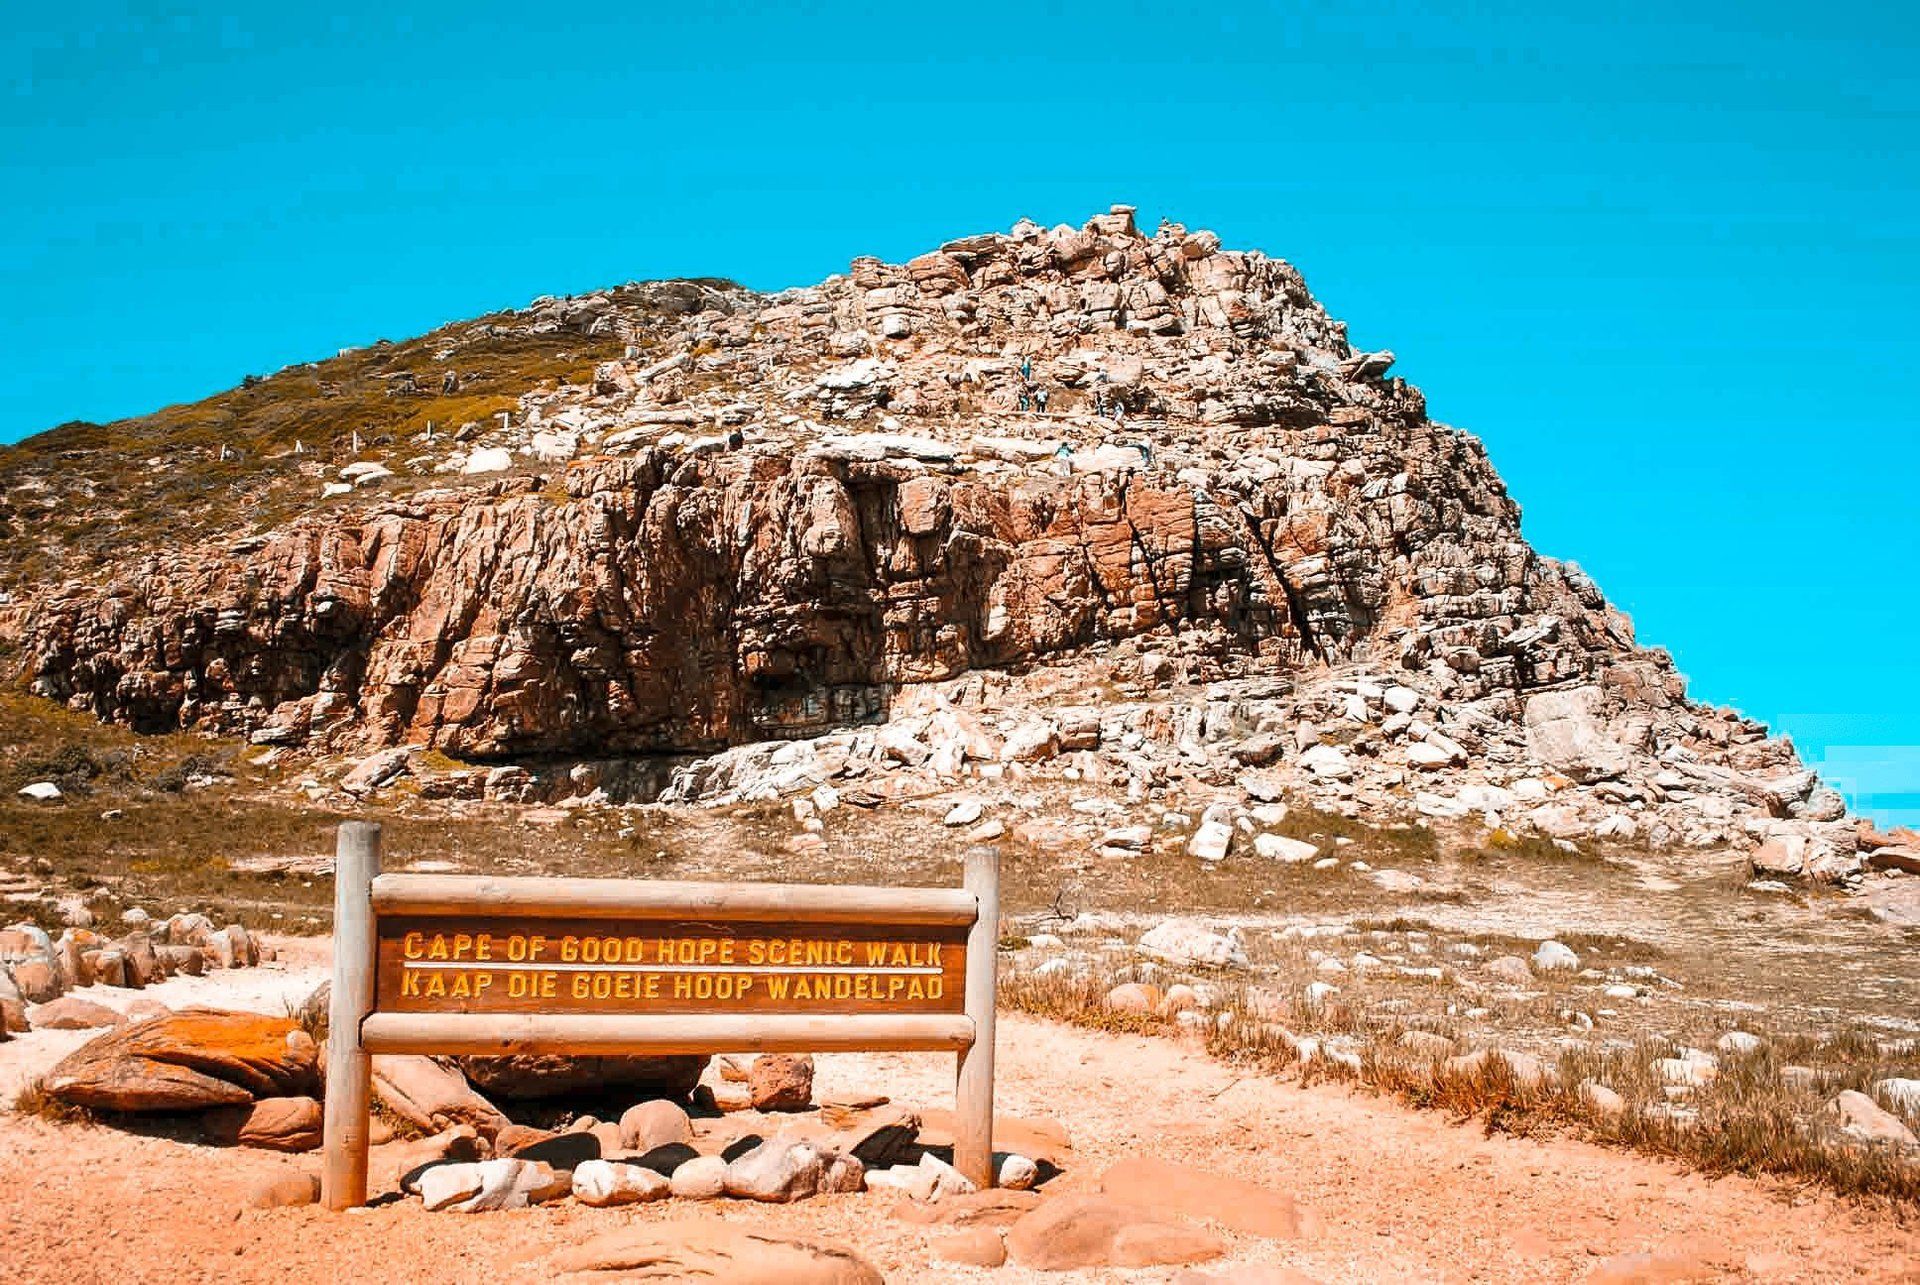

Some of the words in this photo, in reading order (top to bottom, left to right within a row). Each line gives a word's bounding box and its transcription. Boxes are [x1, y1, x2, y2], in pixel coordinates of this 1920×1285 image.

[404, 932, 492, 961] CAPE
[507, 935, 547, 961] OF
[561, 936, 644, 963] GOOD
[657, 938, 735, 964] HOPE
[748, 940, 853, 965] SCENIC
[866, 942, 942, 967] WALK
[401, 969, 493, 998] KAAP
[507, 971, 558, 998] DIE
[570, 973, 661, 999] GOEIE
[673, 974, 753, 1000] HOOP
[766, 974, 944, 1000] WANDELPAD
